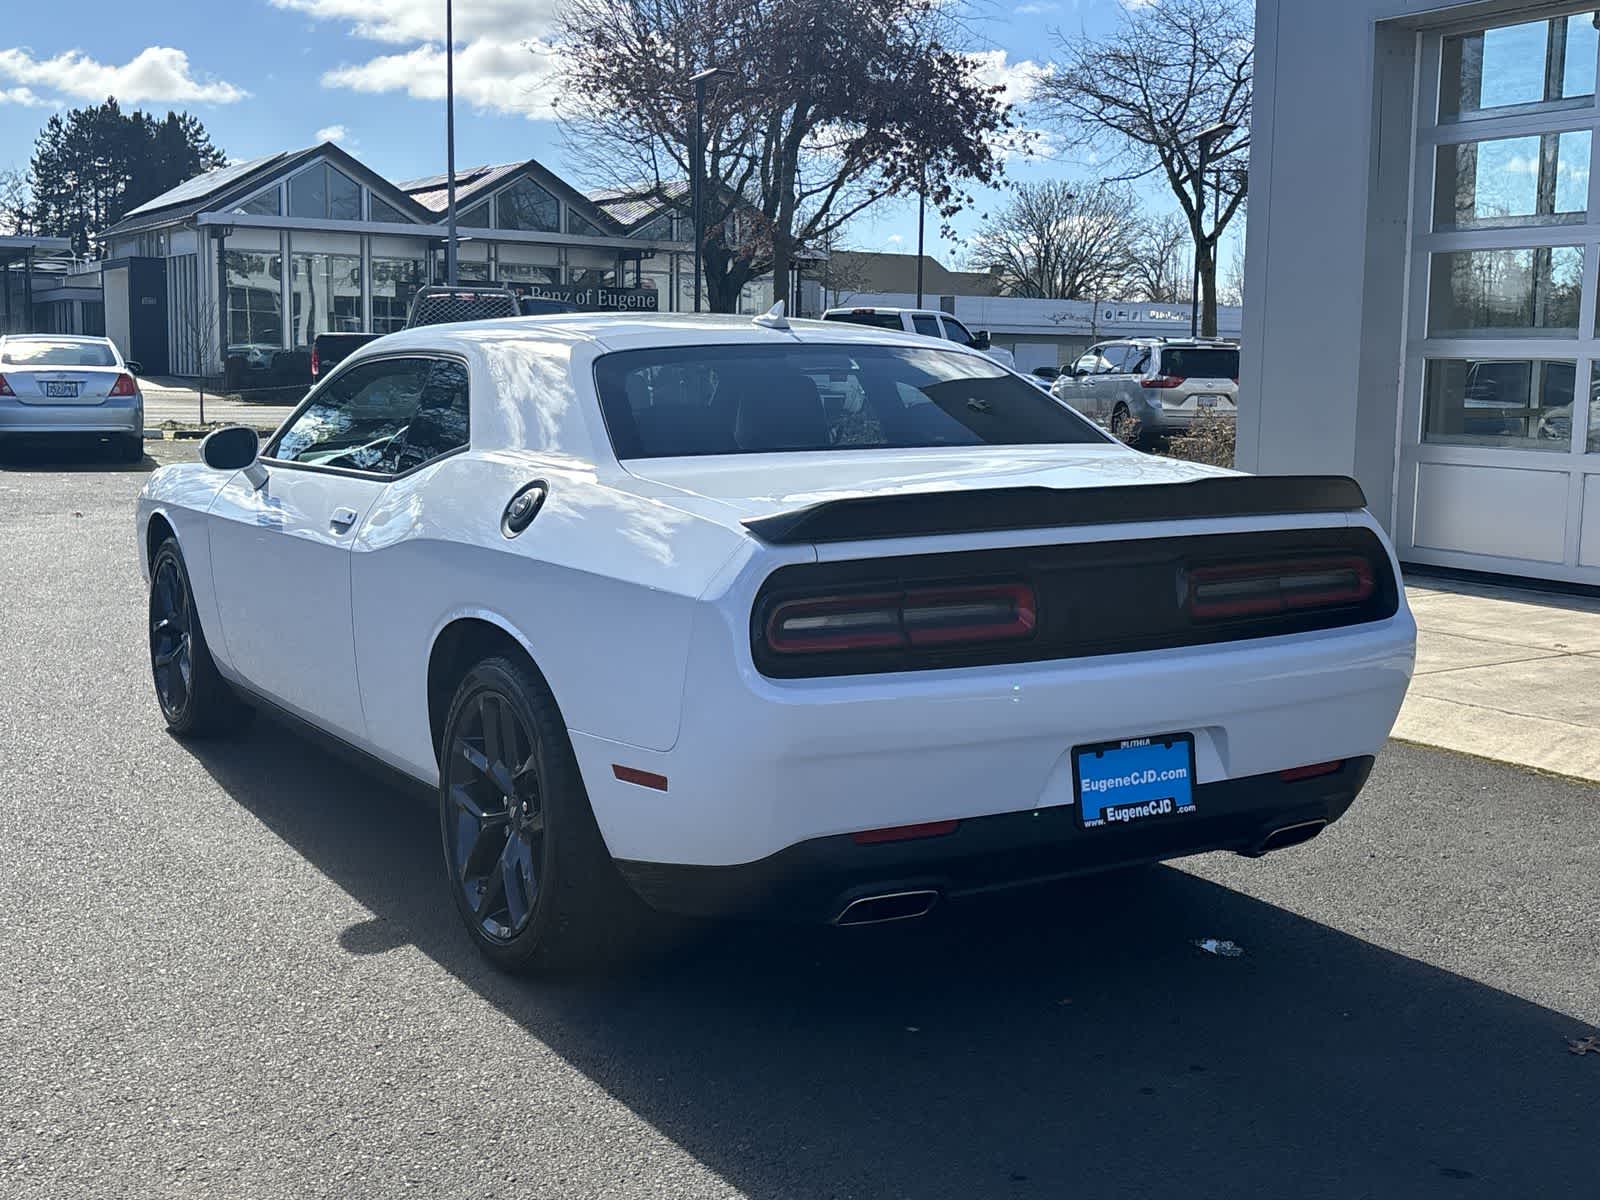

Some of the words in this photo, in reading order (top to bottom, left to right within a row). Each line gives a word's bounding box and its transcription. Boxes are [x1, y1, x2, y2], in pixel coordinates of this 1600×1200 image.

[576, 289, 593, 305] of
[597, 290, 656, 311] Eugene
[1081, 768, 1187, 792] EugeneCJD.com
